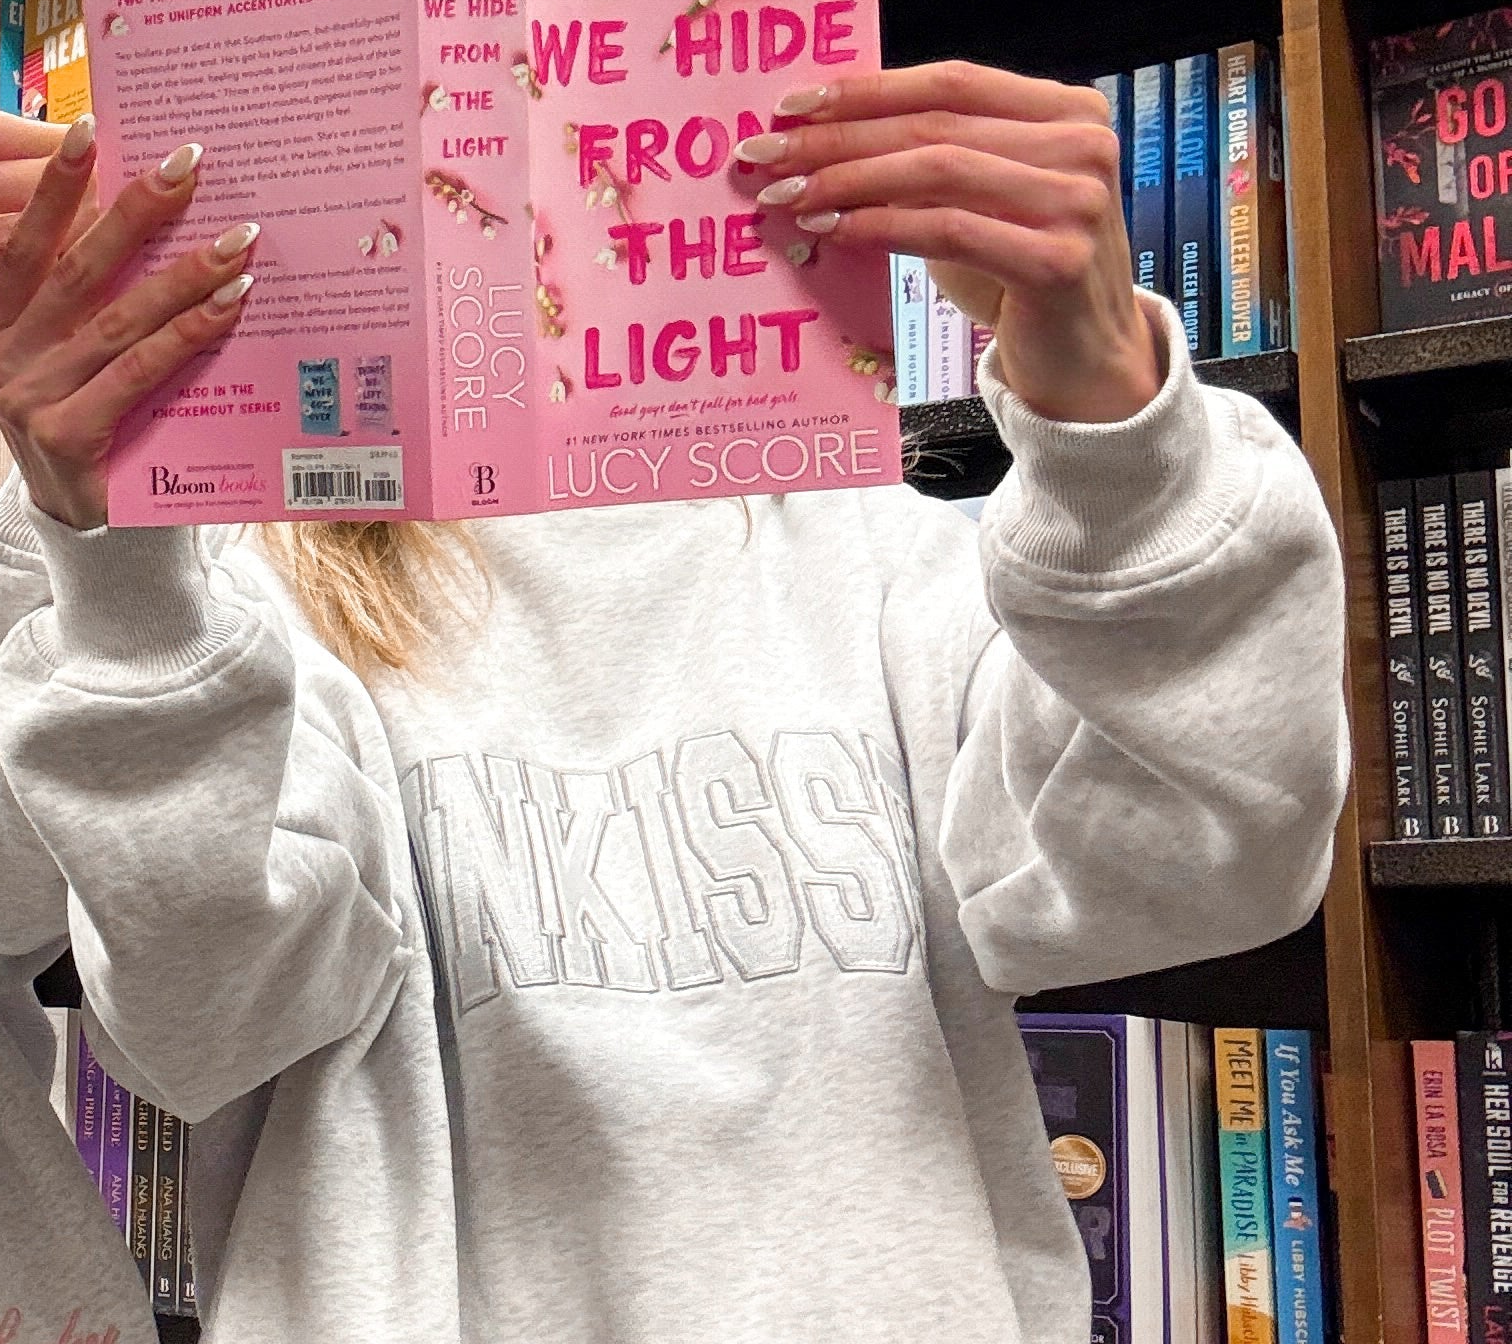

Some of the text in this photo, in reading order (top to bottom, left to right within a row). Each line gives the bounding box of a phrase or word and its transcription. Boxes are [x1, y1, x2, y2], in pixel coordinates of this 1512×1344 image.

[441, 43, 501, 64] FROM
[531, 0, 859, 87] WE HIDE
[451, 90, 494, 111] THE
[1227, 55, 1248, 162] HEART BONES
[442, 136, 509, 159] LIGHT
[608, 213, 768, 285] THE
[1229, 205, 1252, 343] COLLEEN HOOVER
[450, 266, 488, 433] SCORE
[487, 283, 526, 410] LUCY
[584, 308, 819, 390] LIGHT
[151, 401, 281, 420] KNOCKEMOUT SERIES
[179, 383, 255, 399] ALSO IN THE
[583, 433, 609, 445] NEW
[613, 430, 649, 443] YORK
[651, 427, 690, 440] TIMES
[695, 419, 786, 436] BESTSELLING
[792, 414, 850, 428] AUTHOR
[149, 466, 215, 497] Bloom
[219, 471, 267, 493] books
[471, 498, 499, 506] BLOOM
[547, 429, 883, 500] LUCY SCORE
[1384, 508, 1413, 638] THERE IS NO DEVIL
[1393, 700, 1411, 807] SOPHIE LARK
[1274, 1043, 1305, 1187] If You Ask Me
[1428, 1206, 1460, 1332] PLOT TWIST
